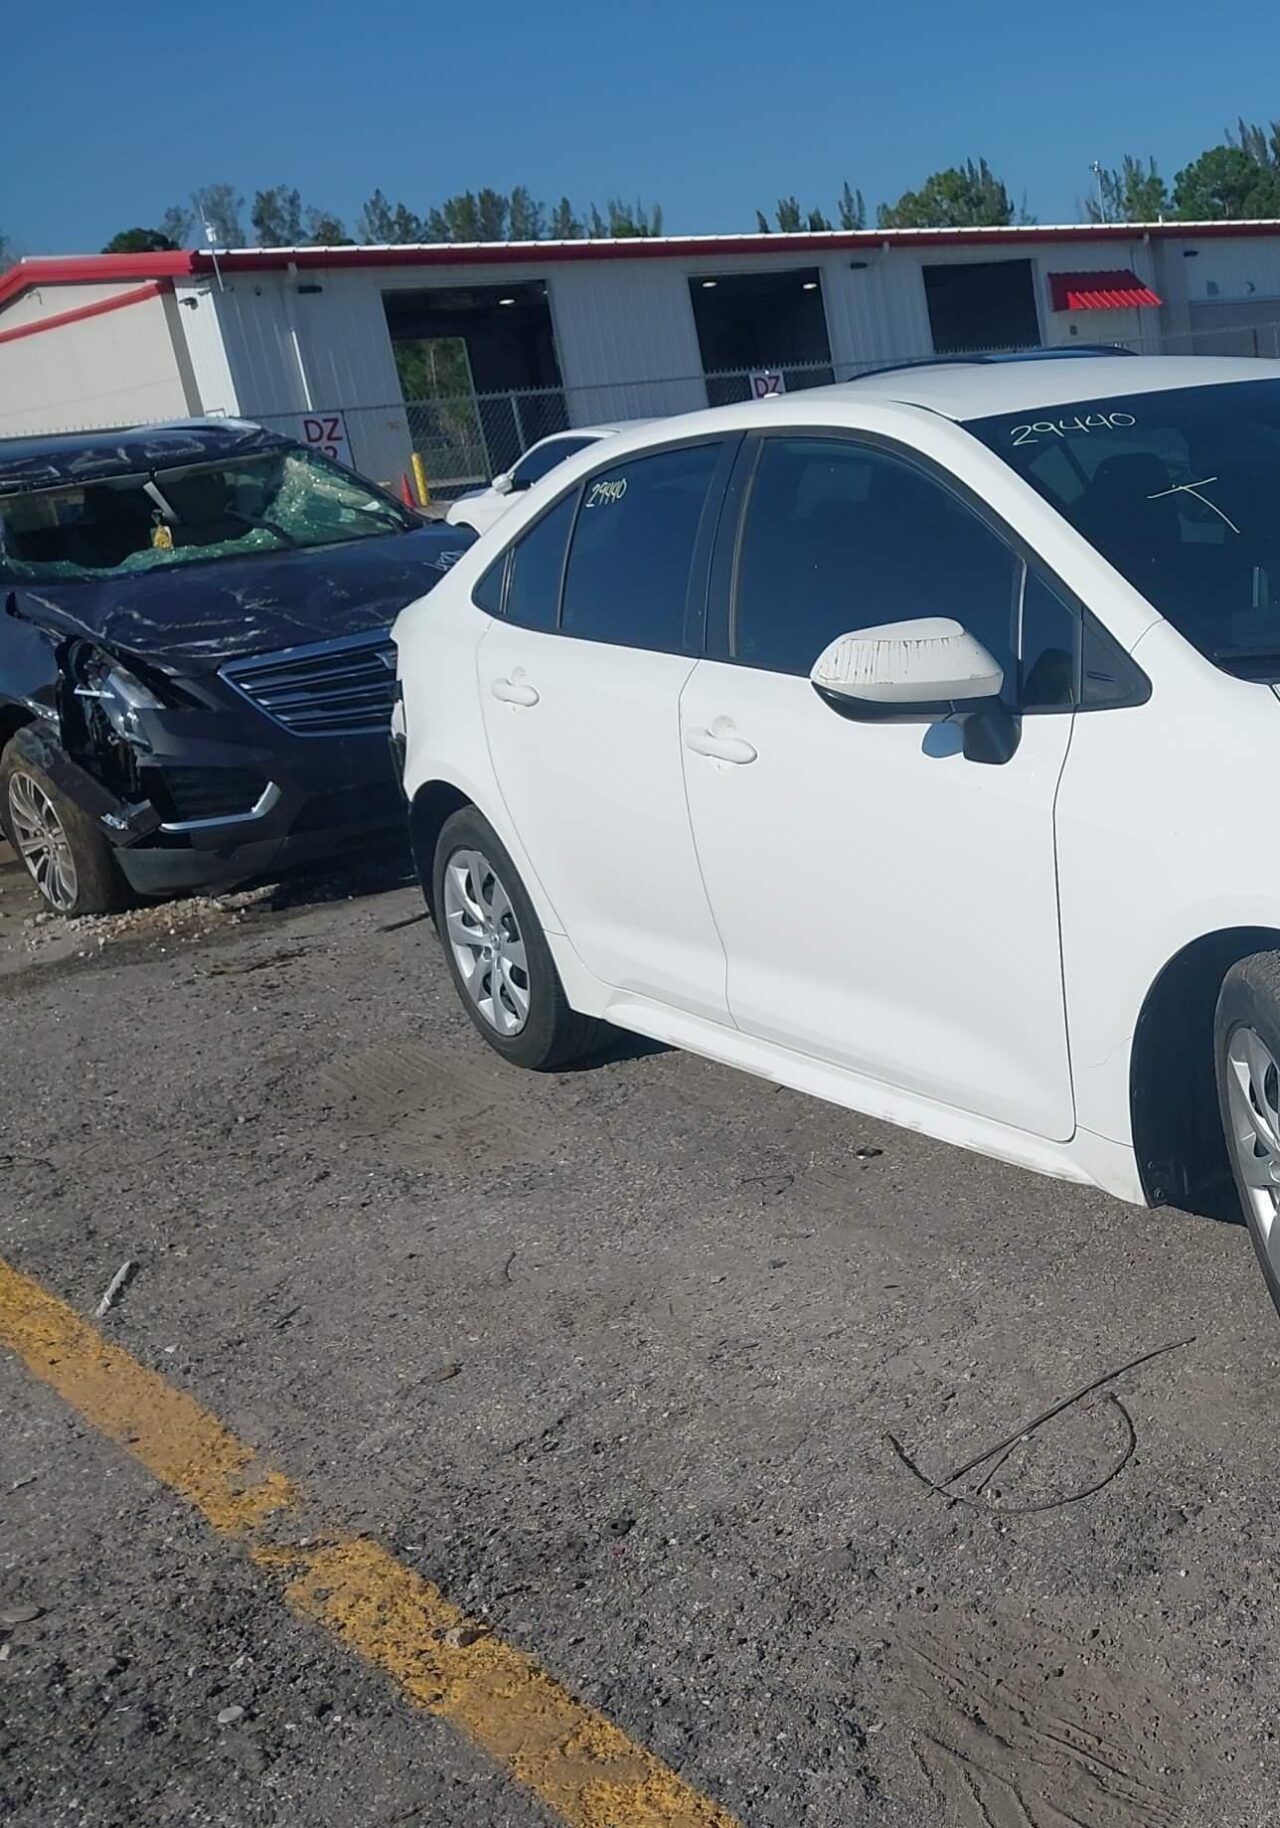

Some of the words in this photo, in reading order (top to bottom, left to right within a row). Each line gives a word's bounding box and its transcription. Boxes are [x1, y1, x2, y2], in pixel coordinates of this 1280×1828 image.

[754, 375, 782, 398] DZ
[303, 417, 343, 443] DZ
[1010, 412, 1136, 446] 29440
[585, 477, 628, 508] 29440
